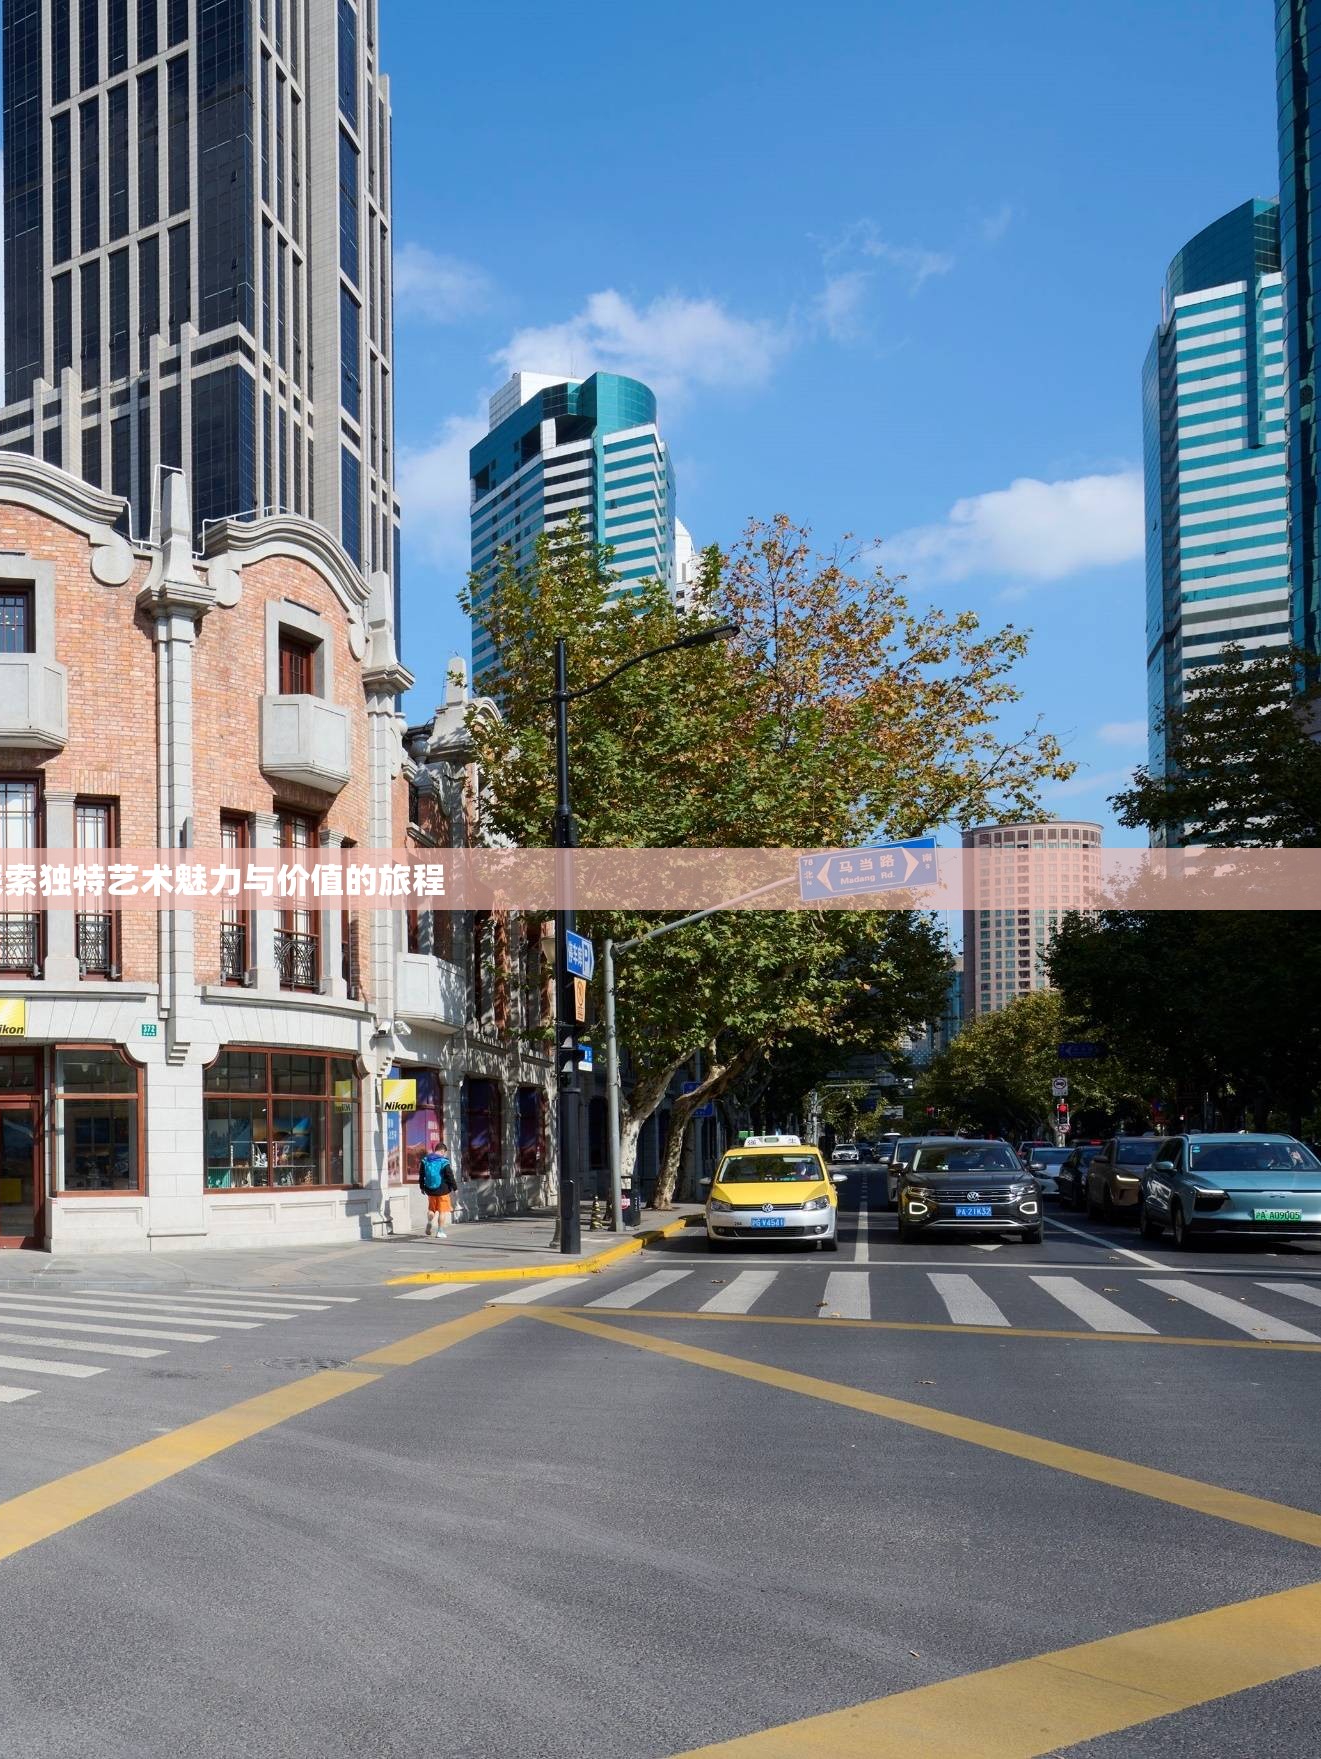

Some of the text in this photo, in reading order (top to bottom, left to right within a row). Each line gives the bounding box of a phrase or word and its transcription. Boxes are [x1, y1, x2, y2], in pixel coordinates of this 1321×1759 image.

[839, 854, 895, 873] 马当路
[804, 870, 814, 880] 北
[840, 870, 896, 886] Madang Rd.
[143, 1025, 155, 1033] 372
[384, 1102, 414, 1110] Nikon
